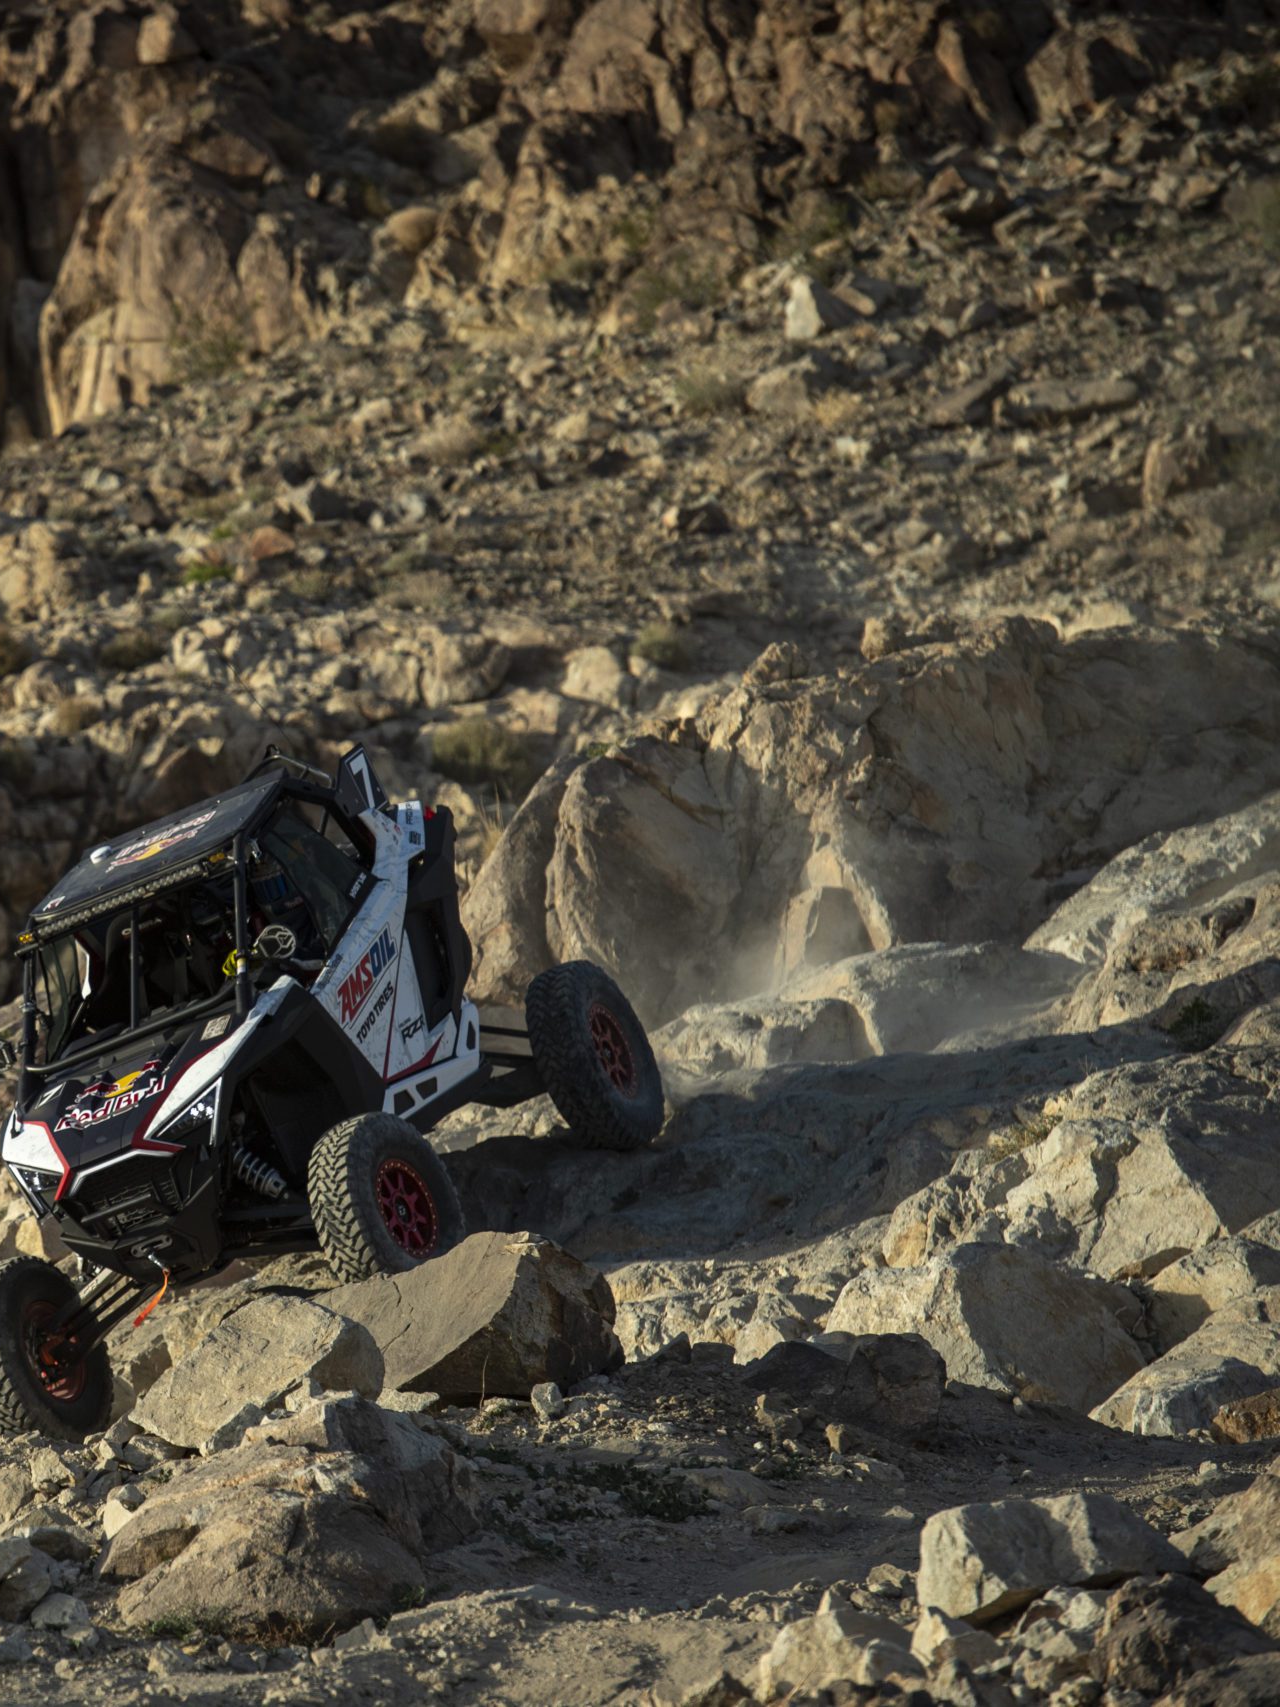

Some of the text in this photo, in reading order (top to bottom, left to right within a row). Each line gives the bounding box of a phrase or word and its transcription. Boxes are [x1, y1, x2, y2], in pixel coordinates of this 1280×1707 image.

[349, 754, 375, 808] 7
[337, 928, 397, 1023] AMSOIL
[356, 982, 394, 1044] TOYO TIRES
